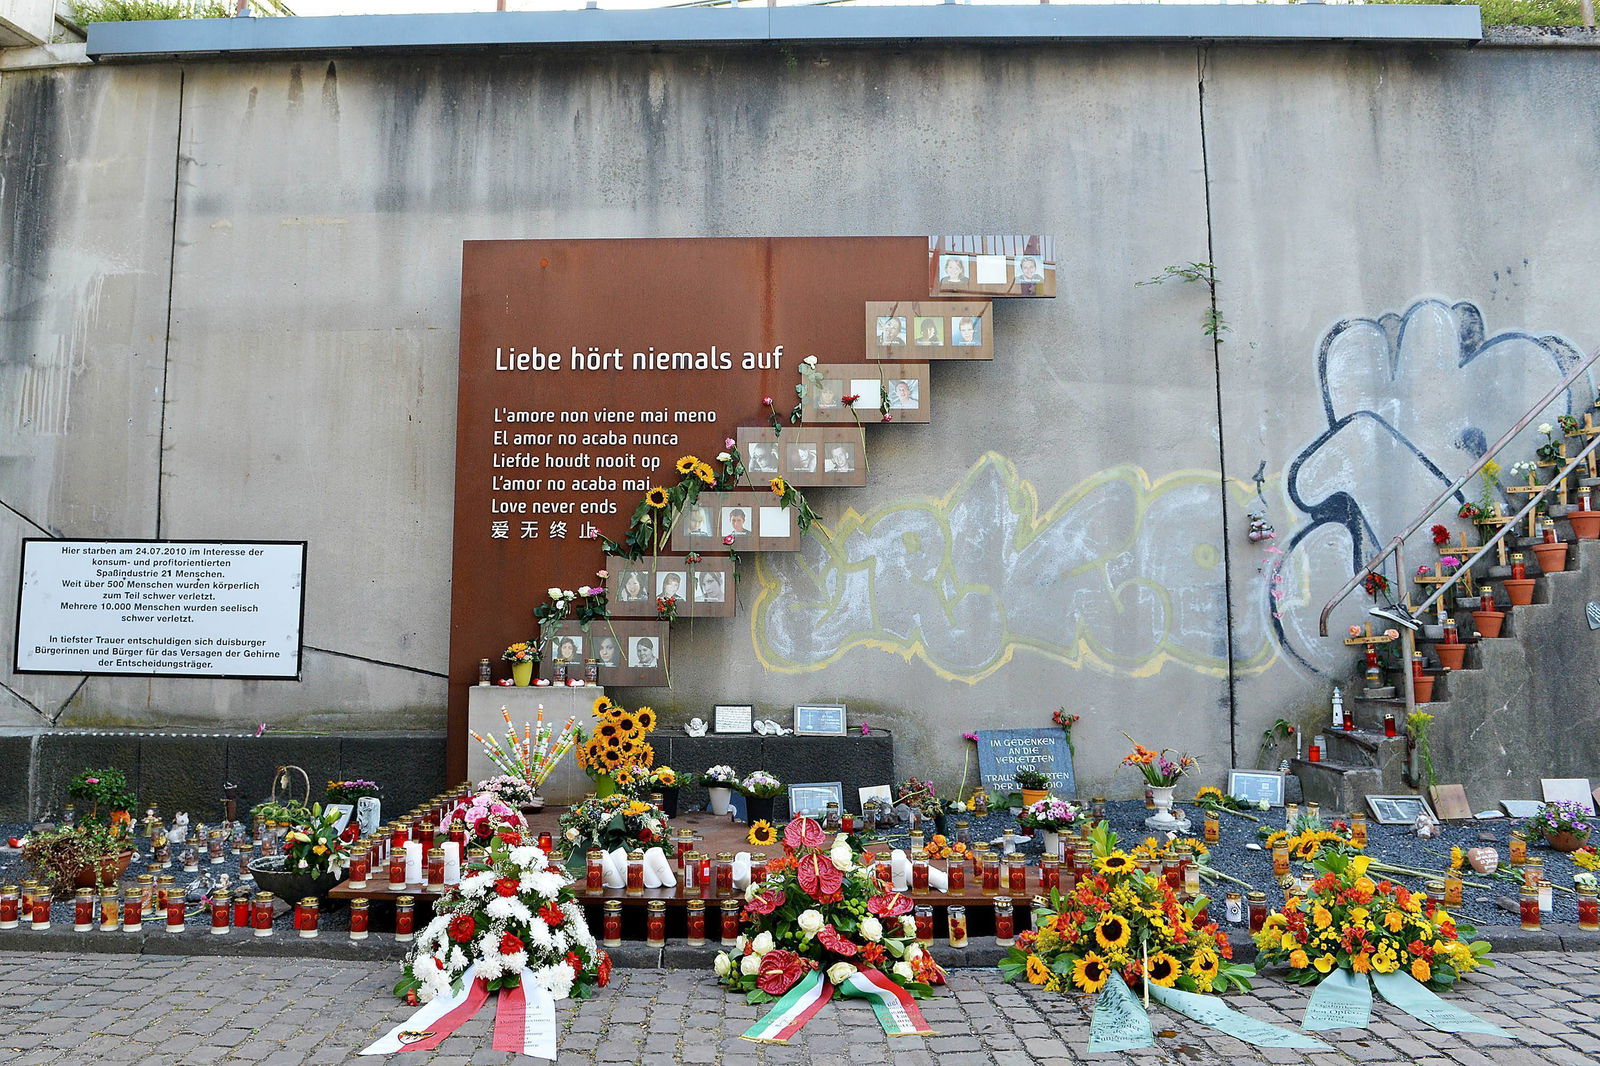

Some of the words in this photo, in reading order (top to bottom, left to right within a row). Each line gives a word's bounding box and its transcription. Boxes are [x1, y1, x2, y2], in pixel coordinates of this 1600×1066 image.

[496, 347, 561, 371] Liebe
[571, 347, 624, 370] hört
[633, 347, 731, 369] niemals
[742, 346, 783, 369] auf
[561, 411, 588, 422] non
[594, 408, 634, 422] viene
[641, 408, 668, 422] mai
[675, 410, 716, 422] meno
[494, 431, 508, 445] El
[514, 433, 553, 445] amor
[559, 433, 576, 445] no
[582, 431, 626, 445] acaba
[633, 433, 678, 445] nunca
[493, 453, 539, 468] Liefde
[546, 453, 590, 468] houdt
[596, 453, 635, 468] nooit
[642, 456, 660, 471] op
[548, 479, 565, 490] no
[572, 476, 616, 490] acaba
[622, 476, 650, 490] mai
[492, 499, 526, 513] Love
[532, 501, 575, 513] never
[580, 499, 617, 513] ends
[62, 547, 80, 555] Hier
[83, 548, 117, 556] starben
[136, 548, 186, 556] 24.07.2010
[189, 548, 200, 556] im
[203, 548, 245, 556] Interesse
[249, 548, 264, 556] der
[153, 559, 230, 568] profitorientierten
[96, 569, 158, 579] Spaßindustrie
[176, 570, 225, 578] Menschen.
[62, 580, 82, 588] Weit
[85, 580, 104, 588] über
[127, 581, 173, 589] Menschen
[177, 581, 209, 589] wurden
[213, 581, 259, 591] körperlich
[125, 591, 139, 599] Teil
[143, 592, 175, 600] schwer
[179, 592, 215, 600] verletzt.
[61, 602, 97, 610] Mehrere
[134, 603, 180, 611] Menschen
[184, 604, 217, 612] wurden
[221, 604, 258, 612] seelisch
[122, 614, 154, 622] schwer
[61, 636, 93, 644] tiefster
[128, 637, 191, 647] entschuldigen
[195, 638, 213, 646] sich
[216, 638, 266, 648] duisburger
[35, 646, 89, 656] Bürgerinnen
[93, 647, 109, 655] und
[112, 648, 142, 657] Bürger
[146, 648, 159, 656] für
[162, 649, 177, 657] das
[180, 649, 222, 659] Versagen
[226, 650, 240, 658] der
[244, 650, 280, 658] Gehirne
[117, 659, 213, 670] Entscheidungsträger.
[1004, 738, 1054, 746] GEDENKEN
[996, 755, 1054, 763] VERLETZTEN
